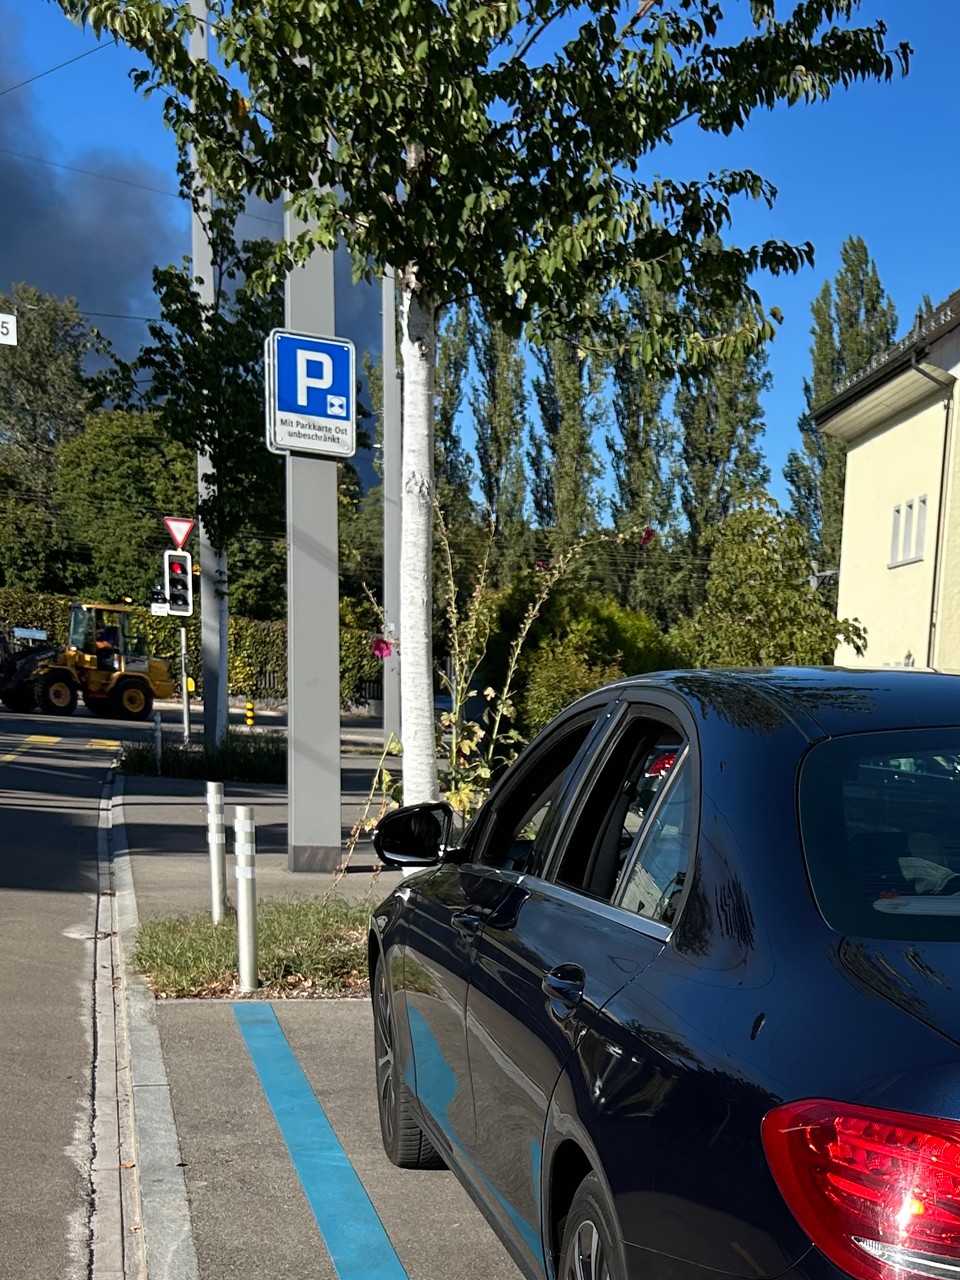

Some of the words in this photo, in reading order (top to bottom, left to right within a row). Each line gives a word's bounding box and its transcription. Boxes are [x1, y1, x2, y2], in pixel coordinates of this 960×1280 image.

[1, 321, 9, 336] 5
[296, 348, 333, 407] P
[280, 418, 294, 428] Mit
[296, 420, 332, 433] Parkkarte
[334, 426, 348, 436] Ost
[288, 430, 340, 444] unbeschränkt
